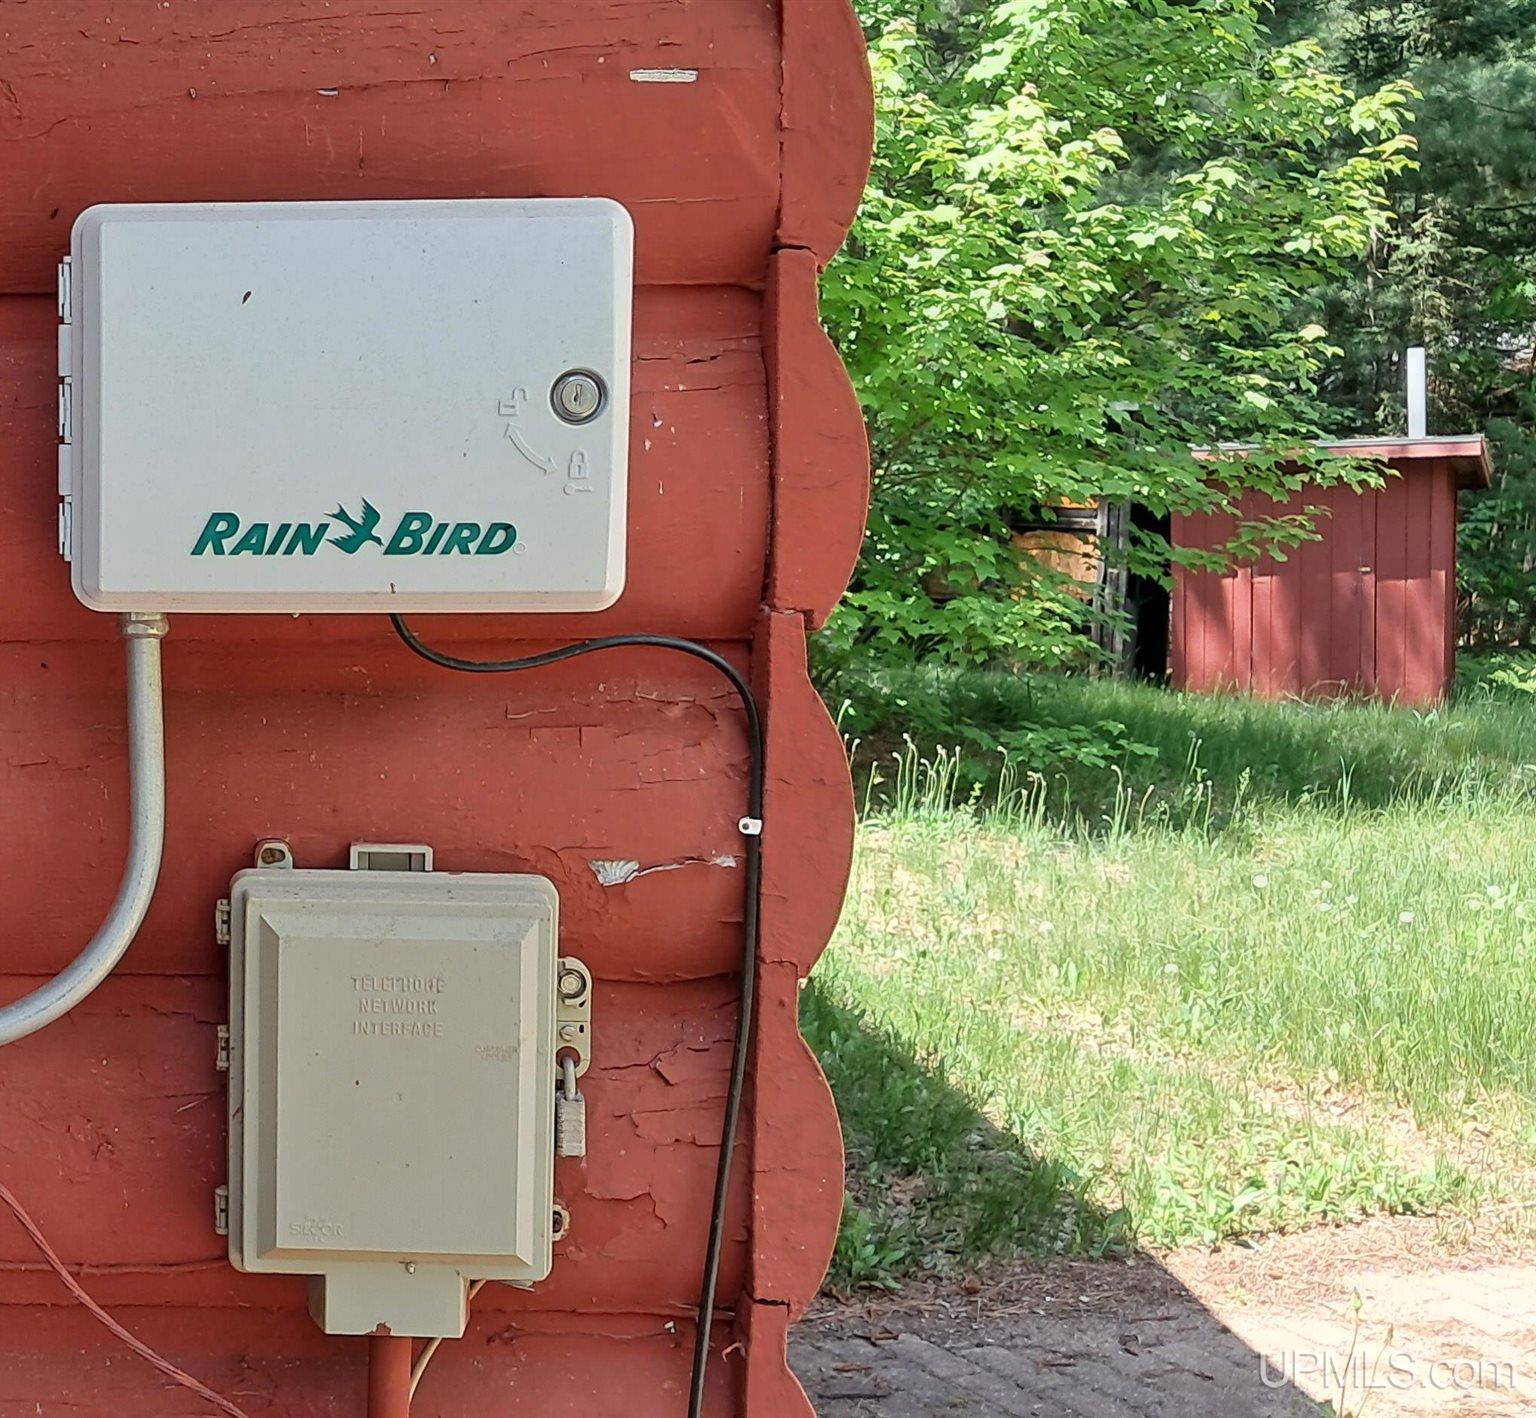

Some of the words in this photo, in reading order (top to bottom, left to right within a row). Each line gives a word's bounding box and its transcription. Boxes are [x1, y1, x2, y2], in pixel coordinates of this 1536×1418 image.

[189, 511, 331, 556] RAIN
[382, 511, 518, 556] BIRD
[350, 975, 446, 994] TELEPHONE
[359, 998, 440, 1015] NETWORK
[352, 1019, 444, 1037] INTERFACE
